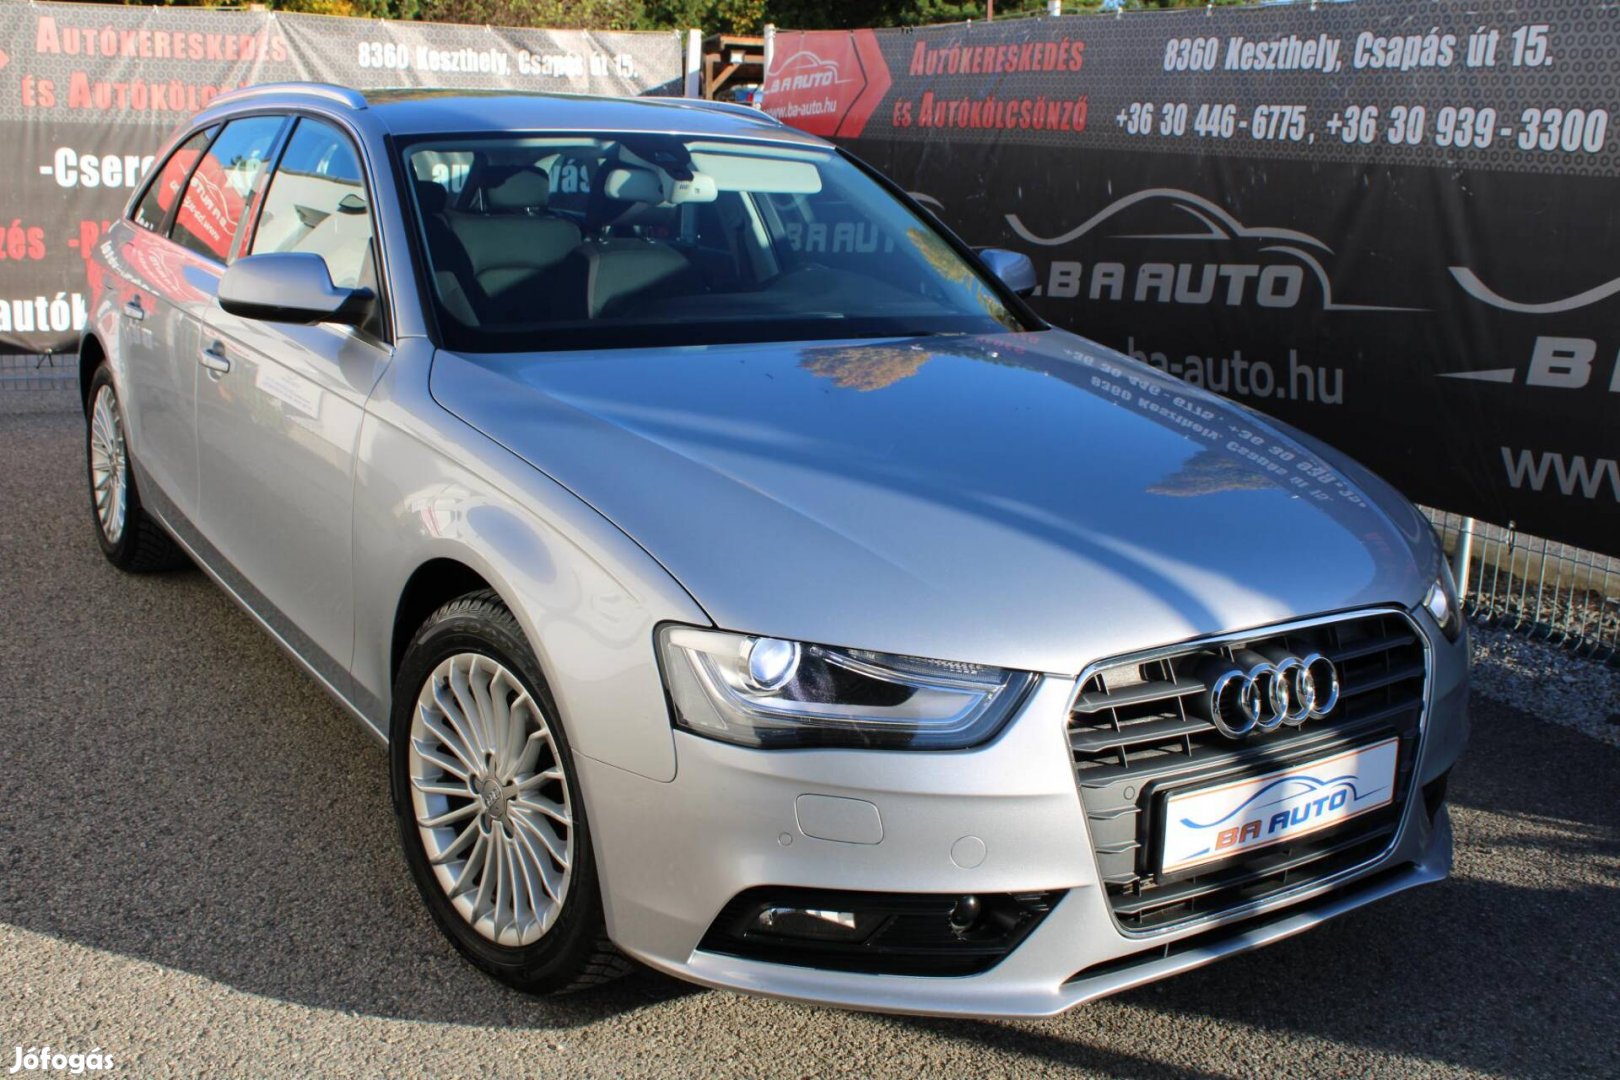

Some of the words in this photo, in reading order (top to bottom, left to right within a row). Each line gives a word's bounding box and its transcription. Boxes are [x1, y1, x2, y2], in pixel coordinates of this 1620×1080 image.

[358, 42, 408, 69] 8360
[416, 47, 511, 75] Keszthely,
[1163, 37, 1219, 71] 8360
[1224, 34, 1342, 73] Keszthely,
[1353, 27, 1456, 70] Csapás
[1466, 25, 1499, 67] út
[1511, 25, 1554, 67] 15.
[68, 71, 247, 110] AUTÓKÖLC
[1116, 102, 1154, 135] +36
[1160, 103, 1188, 136] 30
[1327, 105, 1379, 144] +36
[1388, 105, 1425, 145] 30
[1134, 263, 1304, 308] AUTO
[1526, 336, 1620, 393] B
[1215, 819, 1262, 851] BA
[1268, 788, 1347, 835] AUTO
